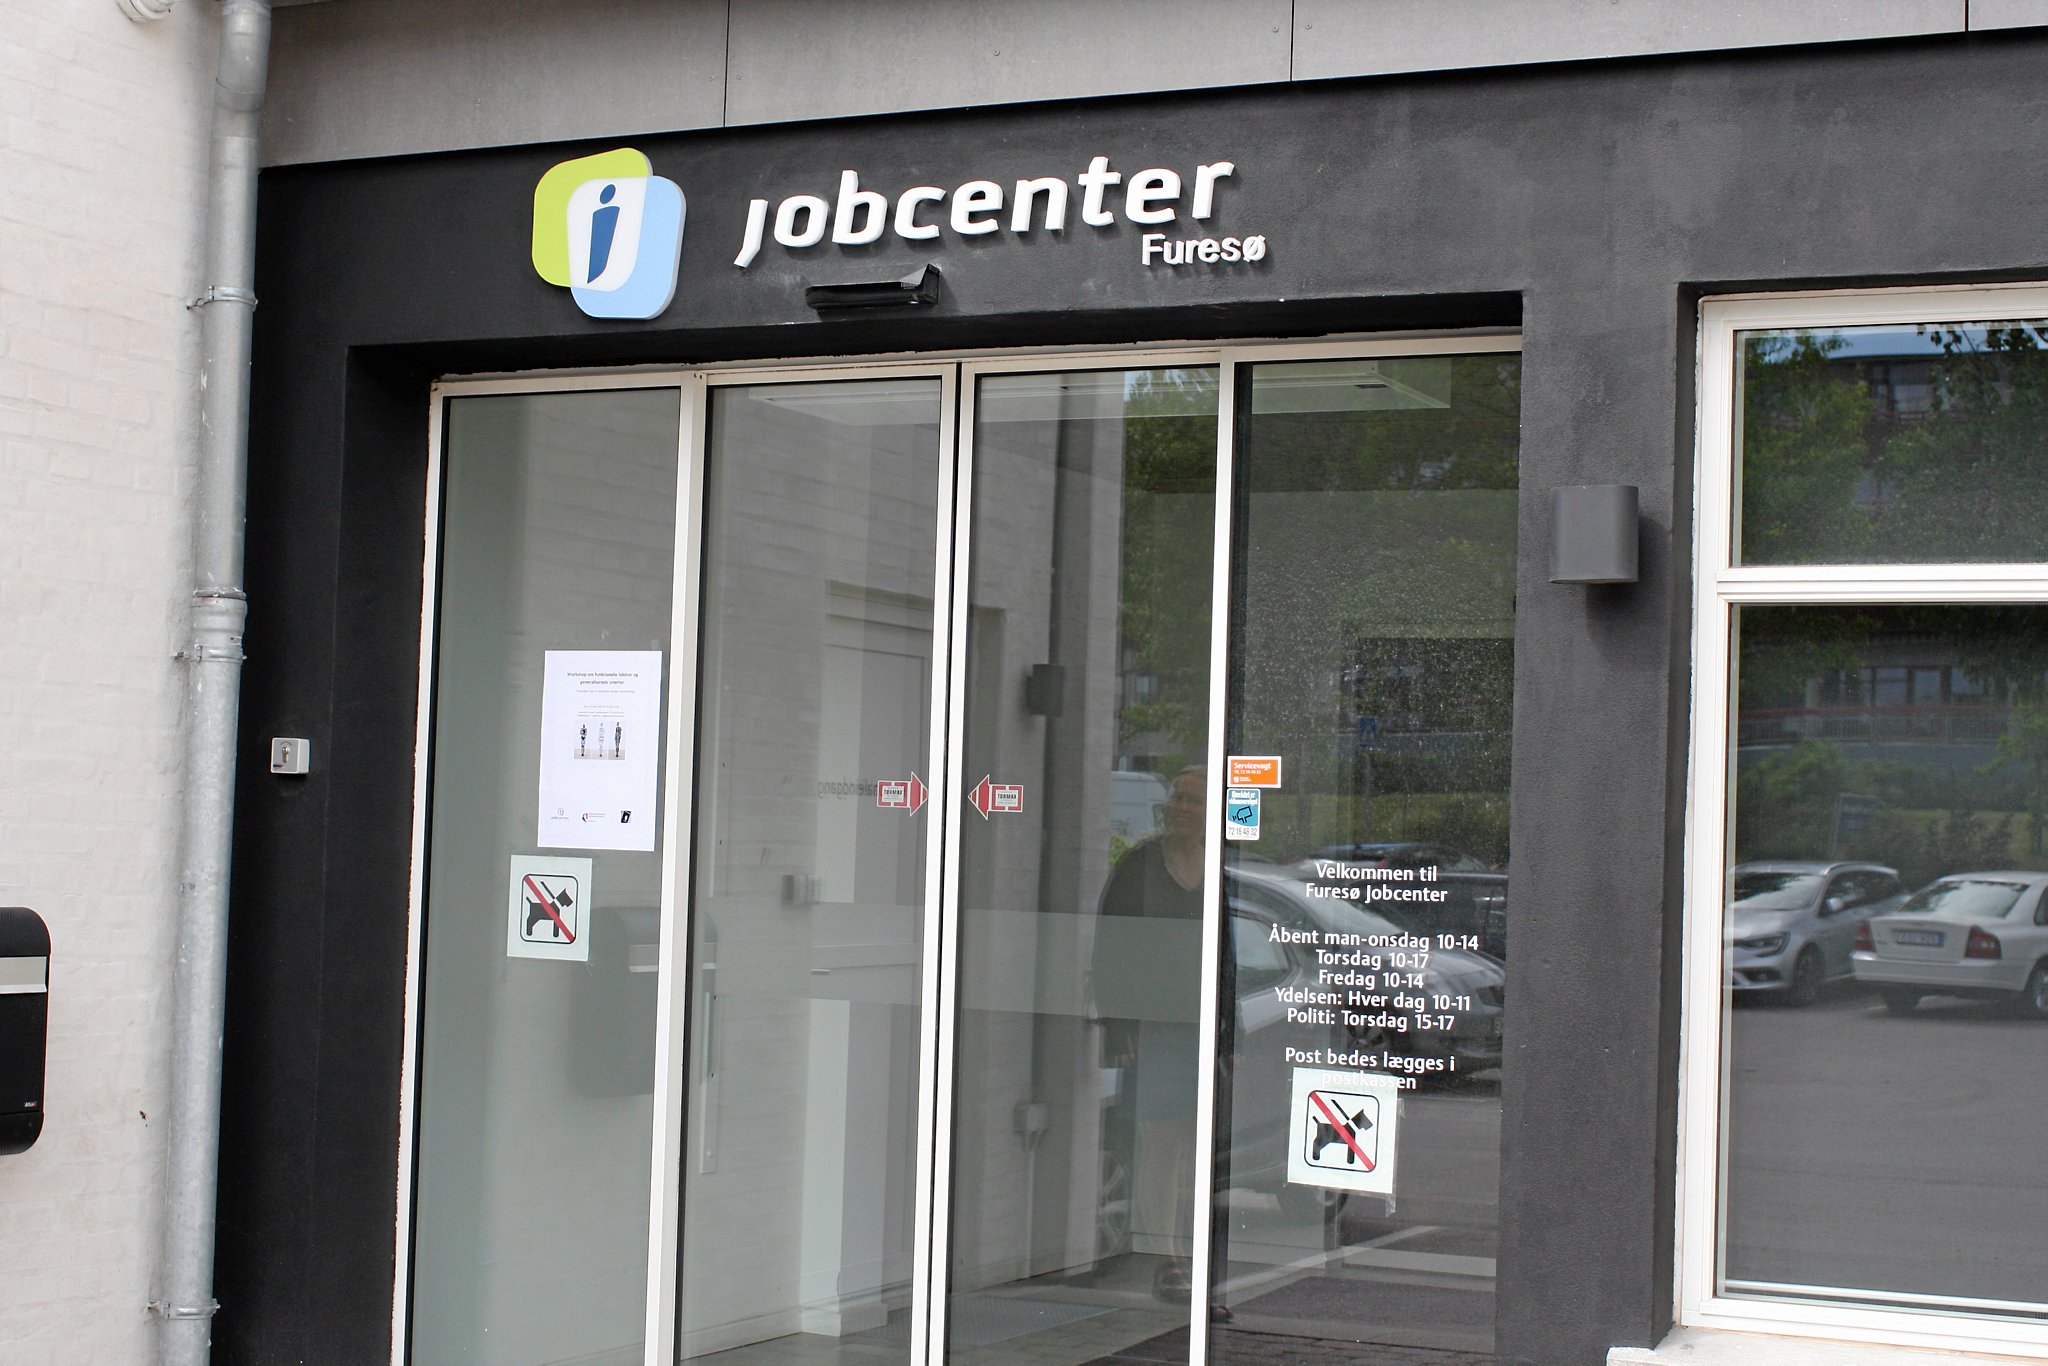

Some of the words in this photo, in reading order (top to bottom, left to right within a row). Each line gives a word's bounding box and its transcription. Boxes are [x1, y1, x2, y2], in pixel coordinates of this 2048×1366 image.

[734, 156, 1235, 267] jobcenter
[1141, 232, 1267, 266] Furesø
[1233, 762, 1271, 770] Servicevagt
[1250, 827, 1258, 836] 32
[1316, 863, 1414, 881] Velkommen
[1419, 865, 1437, 882] til
[1306, 883, 1360, 899] Furesø
[1365, 884, 1448, 903] Jobcenter
[1269, 923, 1319, 944] Åbent
[1325, 931, 1430, 952] man-onsdag
[1437, 934, 1479, 950] 10-14
[1316, 949, 1382, 970] Torsdag
[1389, 953, 1429, 969] 10-17
[1318, 970, 1376, 990] Fredag
[1383, 972, 1424, 989] 10-14
[1275, 986, 1342, 1005] Ydelsen:
[1348, 991, 1388, 1007] Hver
[1393, 992, 1425, 1013] dag
[1432, 995, 1471, 1011] 10-11
[1287, 1008, 1336, 1025] Politi:
[1341, 1010, 1408, 1032] Torsdag
[1415, 1014, 1455, 1030] 15-17
[1285, 1047, 1321, 1064] Post
[1327, 1048, 1378, 1067] bedes
[1383, 1051, 1444, 1073] lægges
[1449, 1055, 1455, 1072] i
